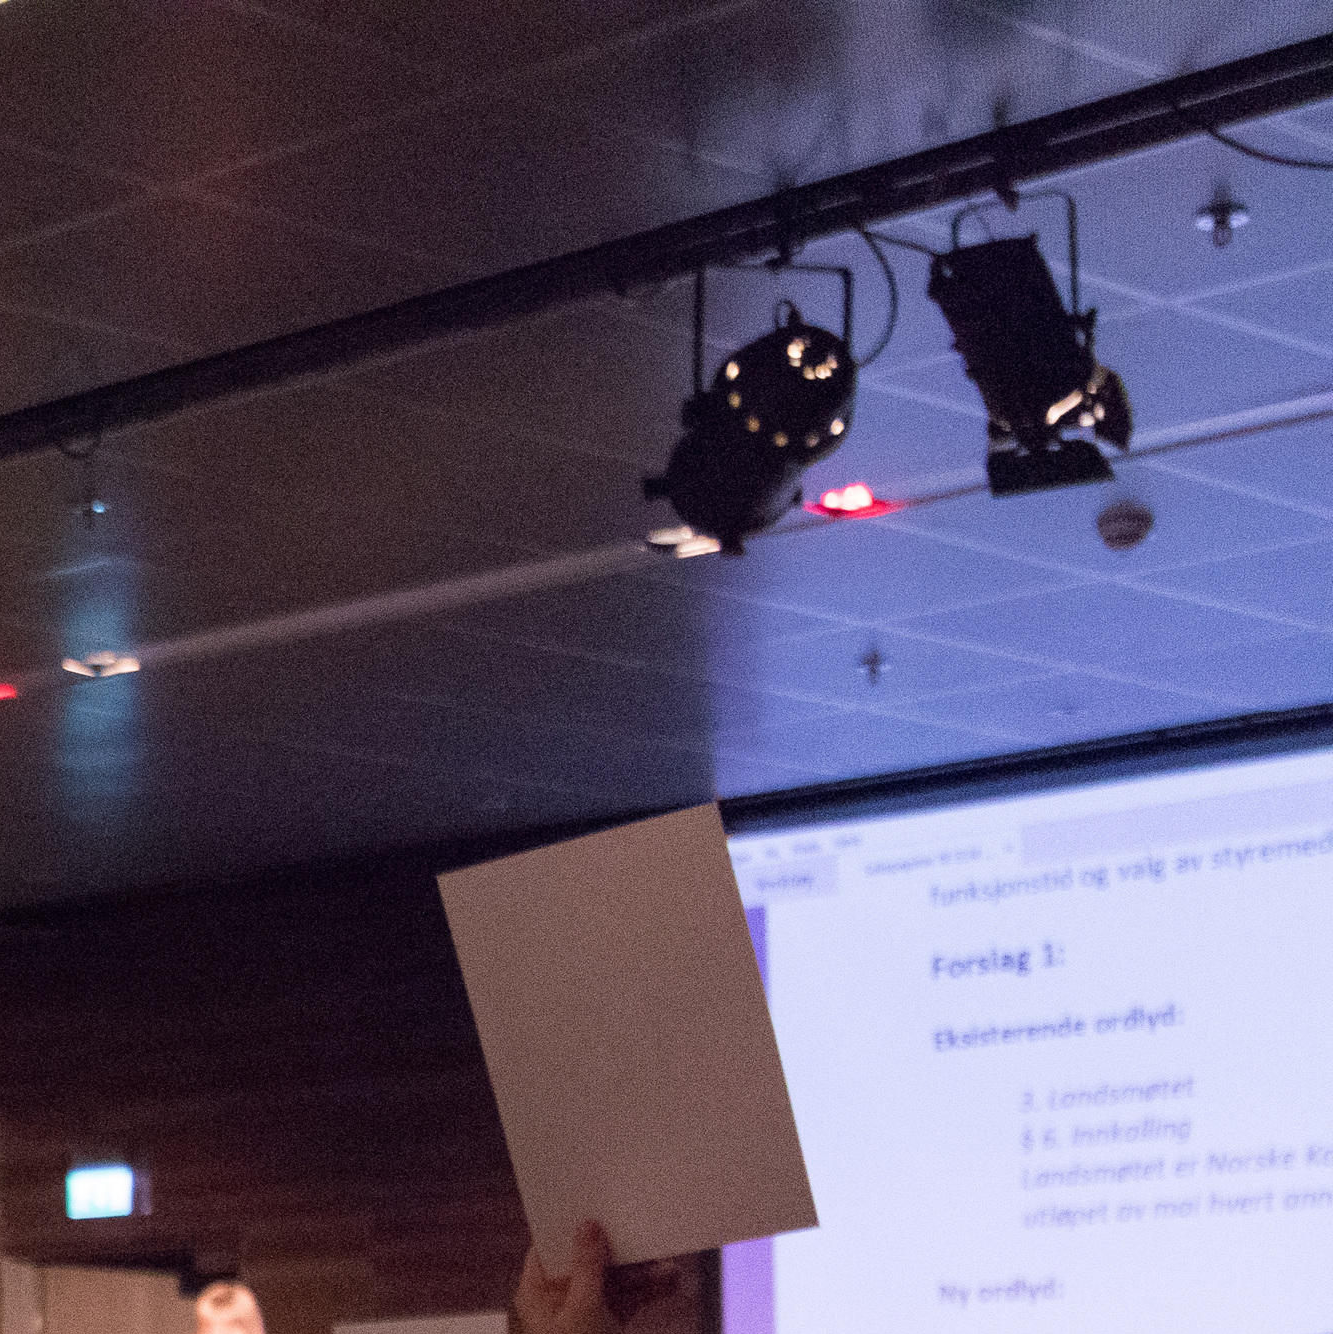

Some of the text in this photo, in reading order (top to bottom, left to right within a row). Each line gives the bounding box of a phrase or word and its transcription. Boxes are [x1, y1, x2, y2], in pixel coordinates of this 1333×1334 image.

[930, 940, 1066, 980] Forslag 1:
[937, 1282, 970, 1310] Ny
